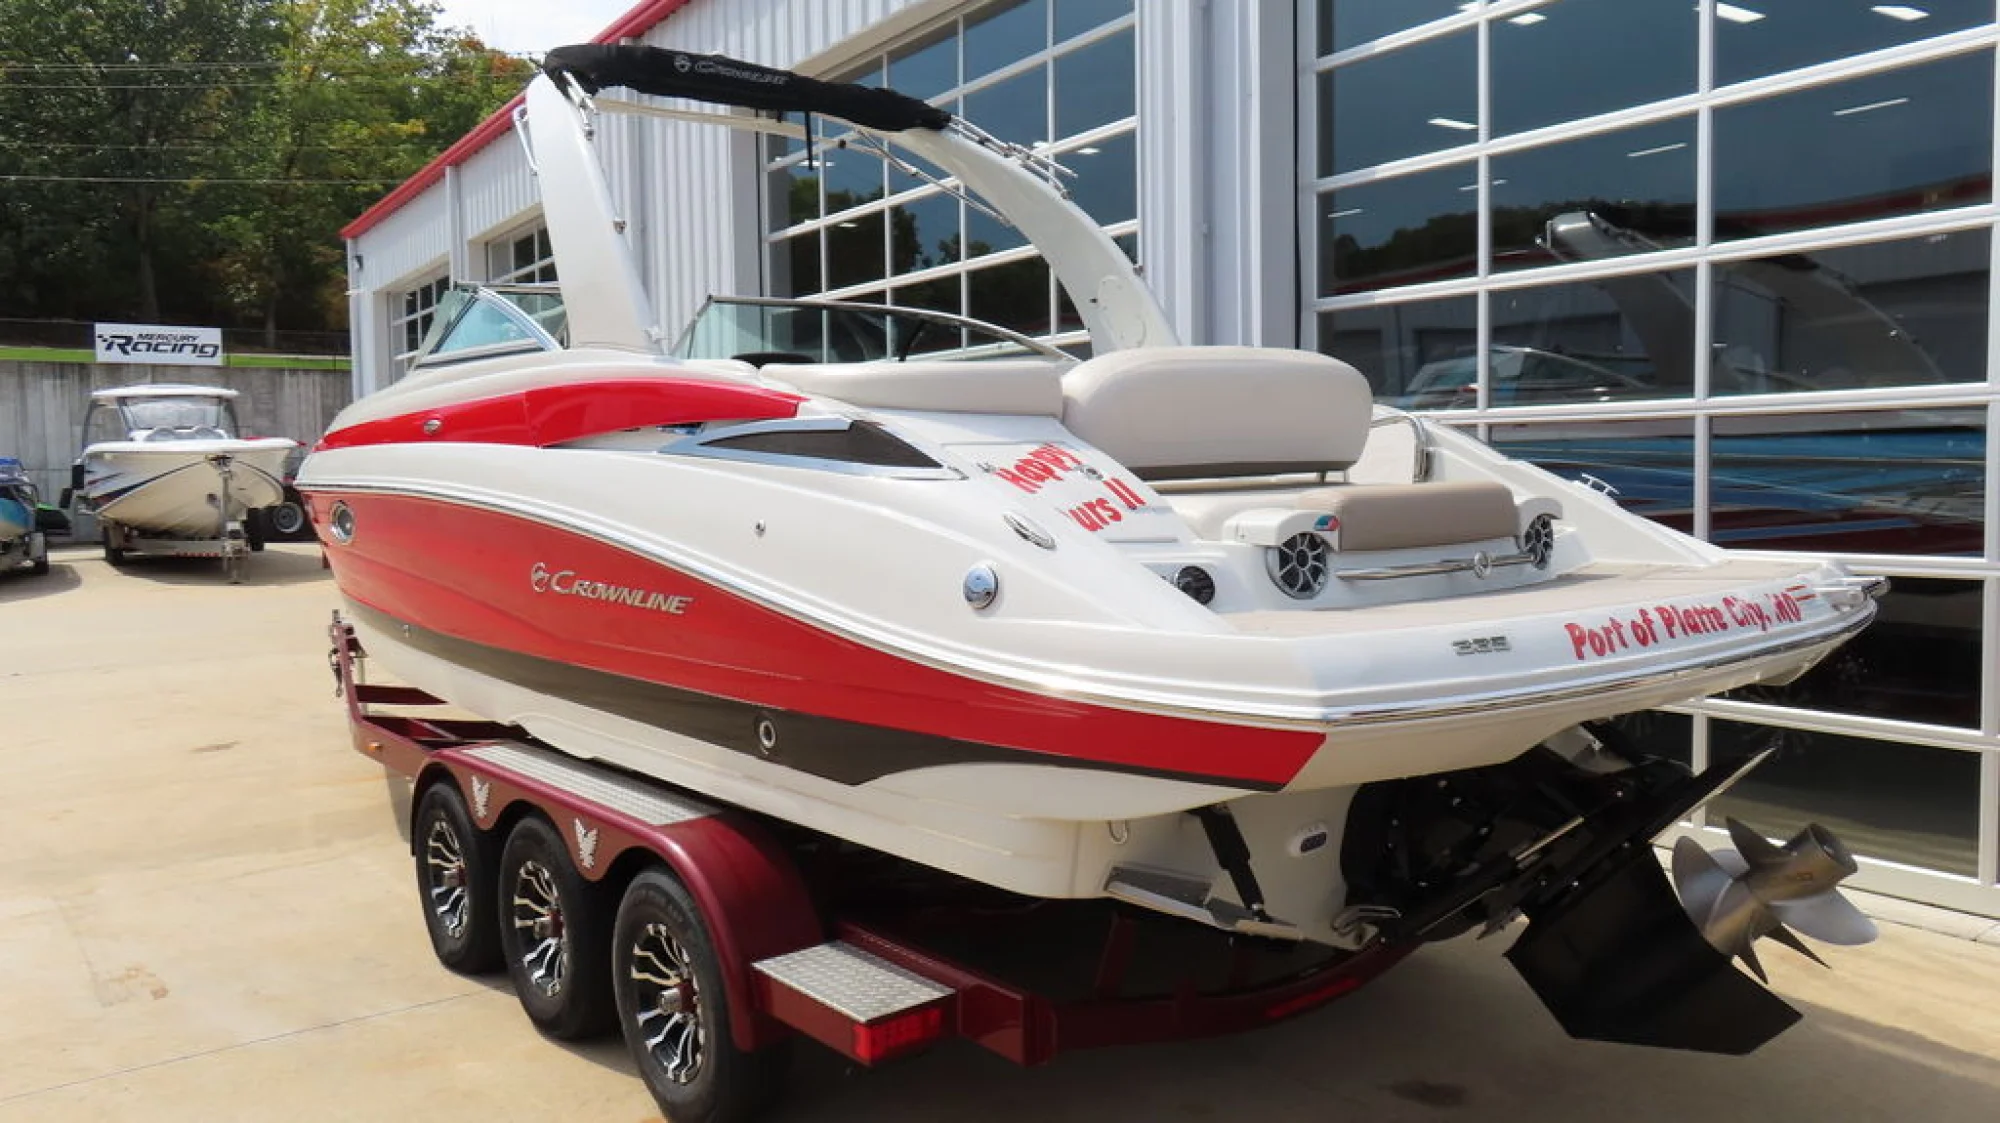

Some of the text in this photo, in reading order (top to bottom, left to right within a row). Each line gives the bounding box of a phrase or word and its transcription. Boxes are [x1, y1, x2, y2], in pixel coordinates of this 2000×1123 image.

[104, 335, 220, 358] Racing
[136, 333, 200, 343] MERCURY
[550, 570, 694, 615] CROWNLINE
[1564, 616, 1629, 661] Port
[1631, 608, 1659, 648] of
[1654, 604, 1729, 640] Platte
